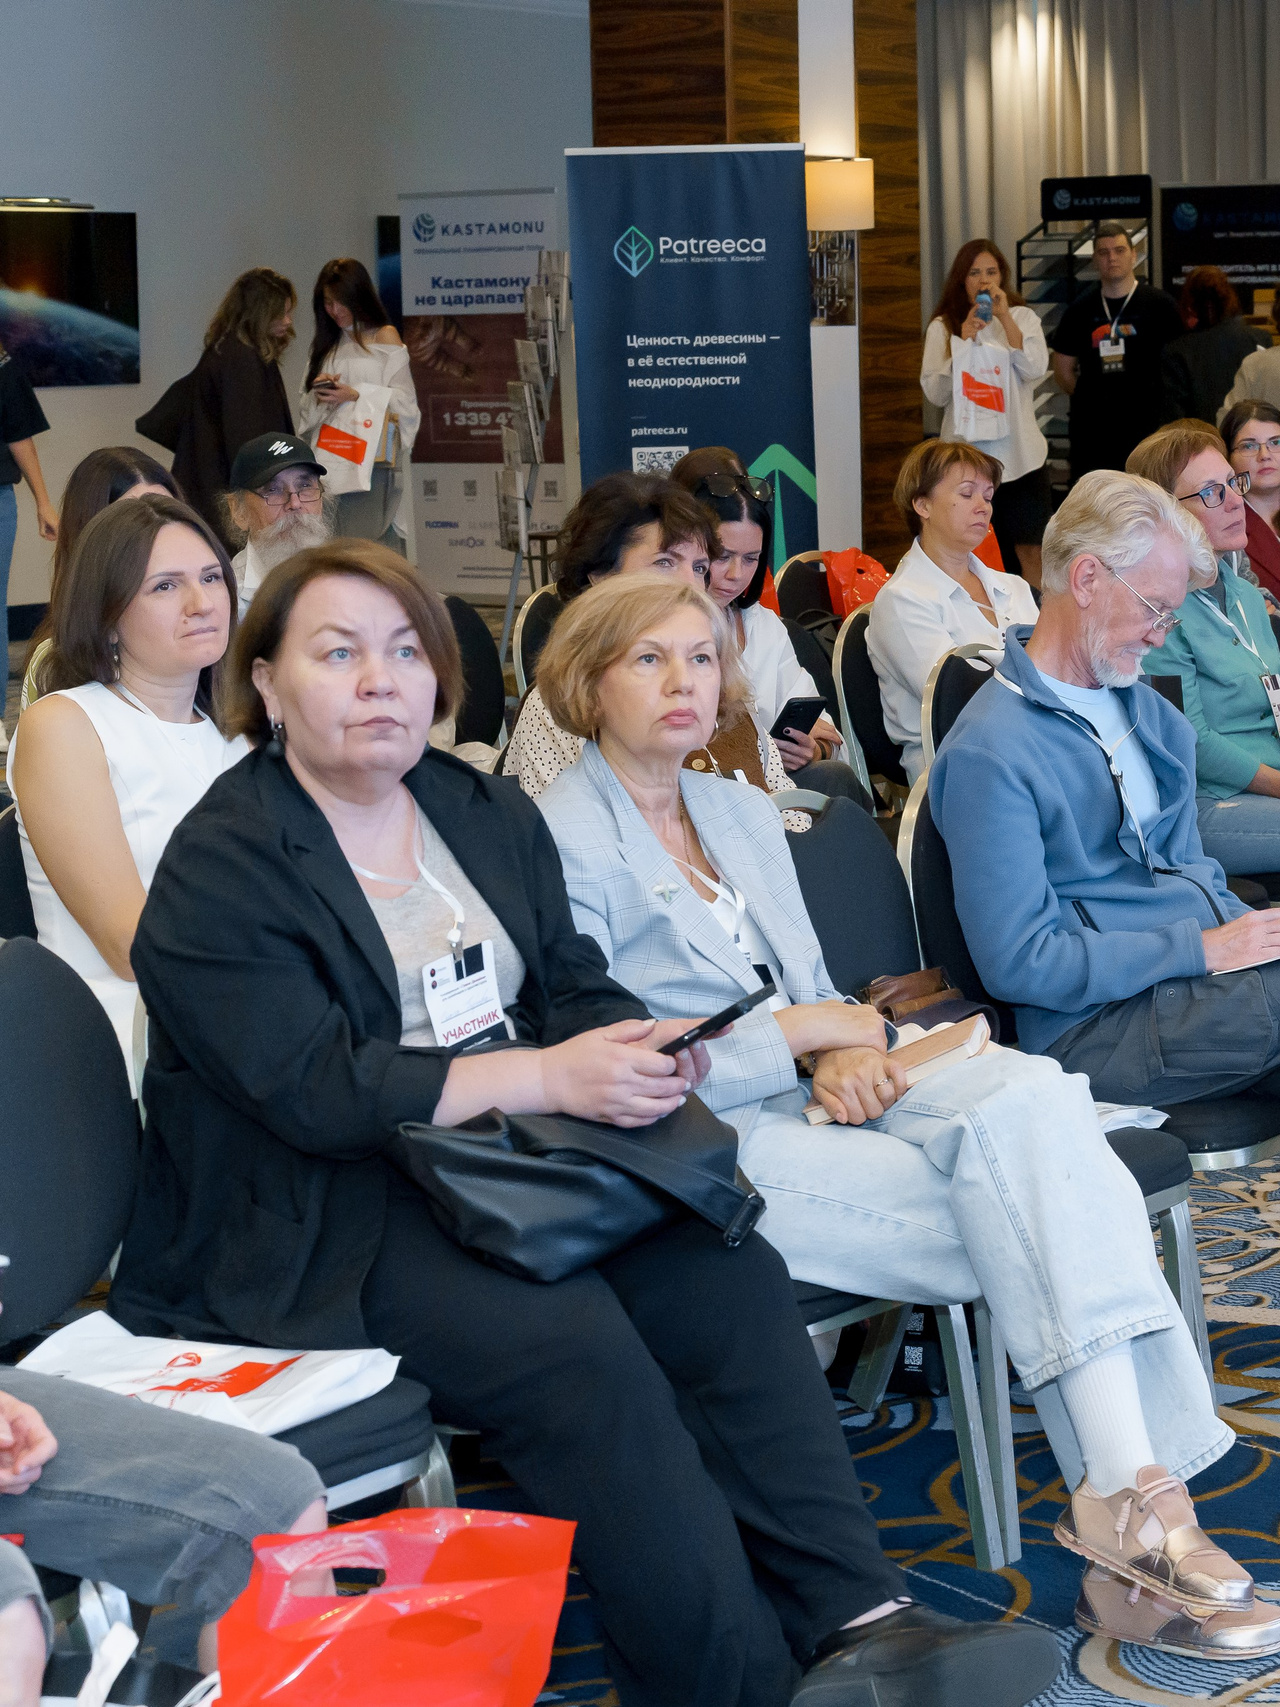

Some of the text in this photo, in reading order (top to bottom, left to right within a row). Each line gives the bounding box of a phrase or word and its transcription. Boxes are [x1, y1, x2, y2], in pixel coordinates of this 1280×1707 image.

[441, 221, 544, 236] KASTAMONU
[659, 237, 766, 254] Patreeca
[731, 255, 767, 263] Комфорт.
[431, 276, 530, 290] Кастамону
[415, 291, 525, 308] не царапает
[626, 335, 690, 348] Ценность
[693, 334, 766, 347] древесины
[627, 353, 747, 367] в её естественной
[628, 376, 740, 389] неоднородности
[631, 427, 688, 437] patreeca.ru
[442, 1009, 500, 1045] УЧАСТНИК
